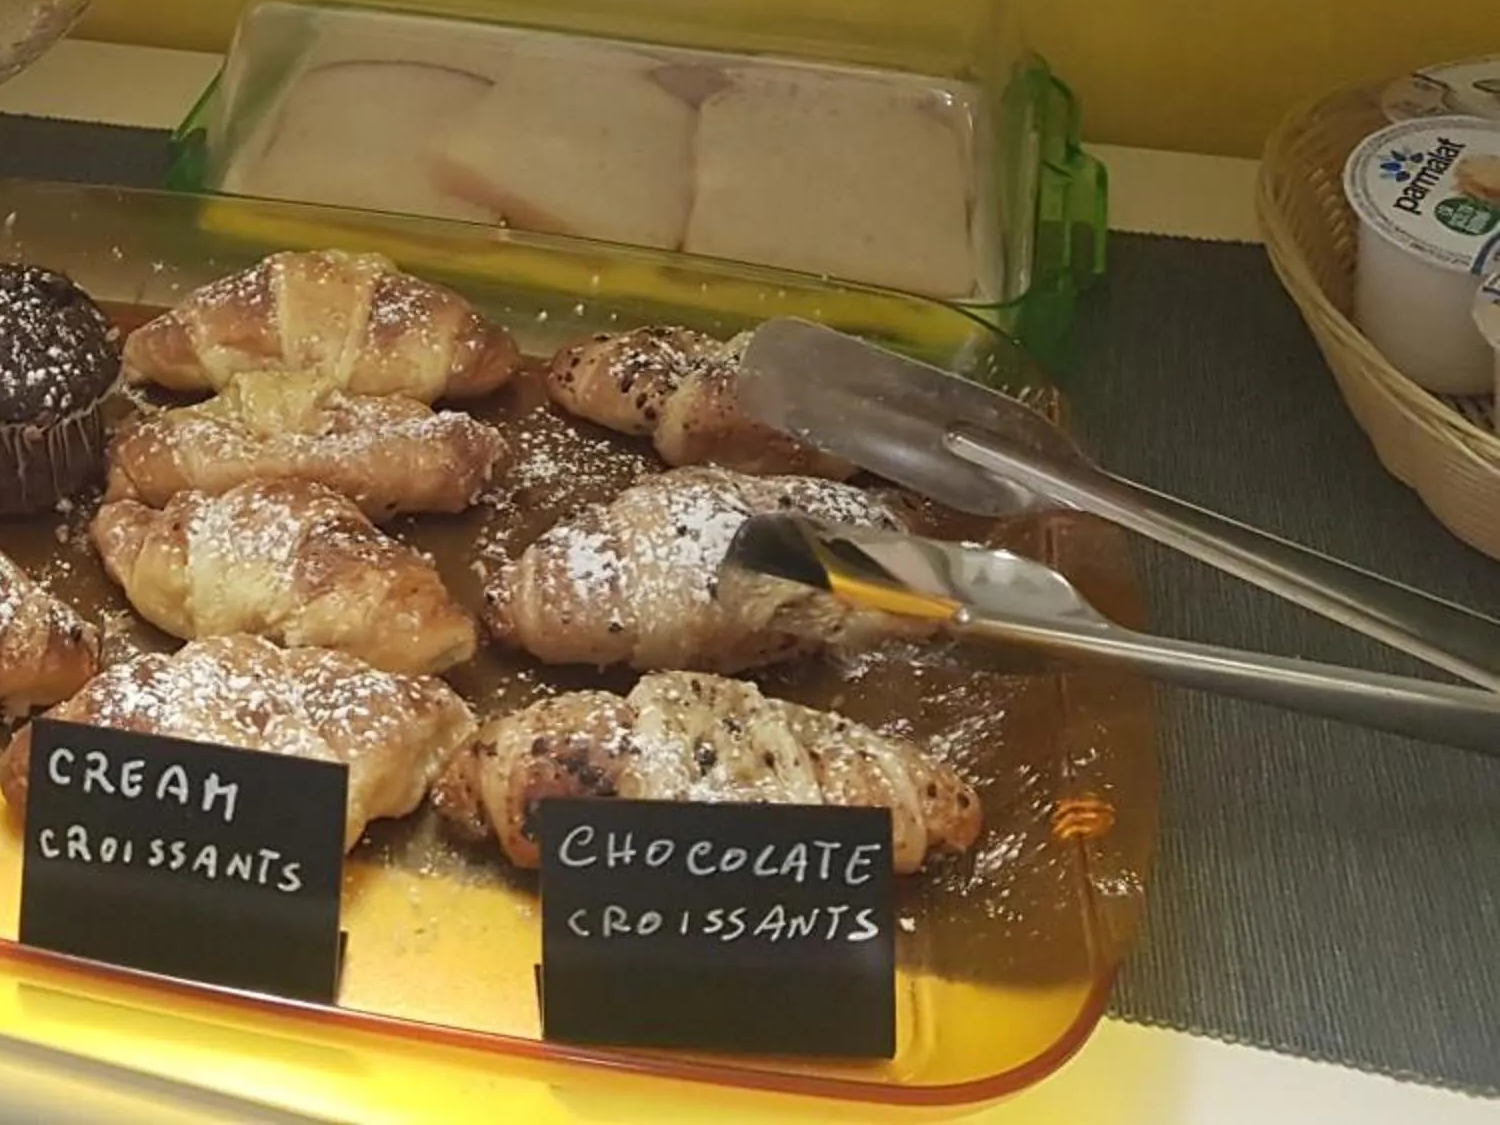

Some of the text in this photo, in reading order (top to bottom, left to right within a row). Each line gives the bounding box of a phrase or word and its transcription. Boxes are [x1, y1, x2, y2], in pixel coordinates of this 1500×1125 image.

[1393, 136, 1467, 216] parmalat
[47, 747, 240, 822] CREAM
[39, 824, 304, 893] CROISSANTS
[558, 824, 882, 885] CHOCOLATE
[567, 904, 880, 941] CROISSANTS
